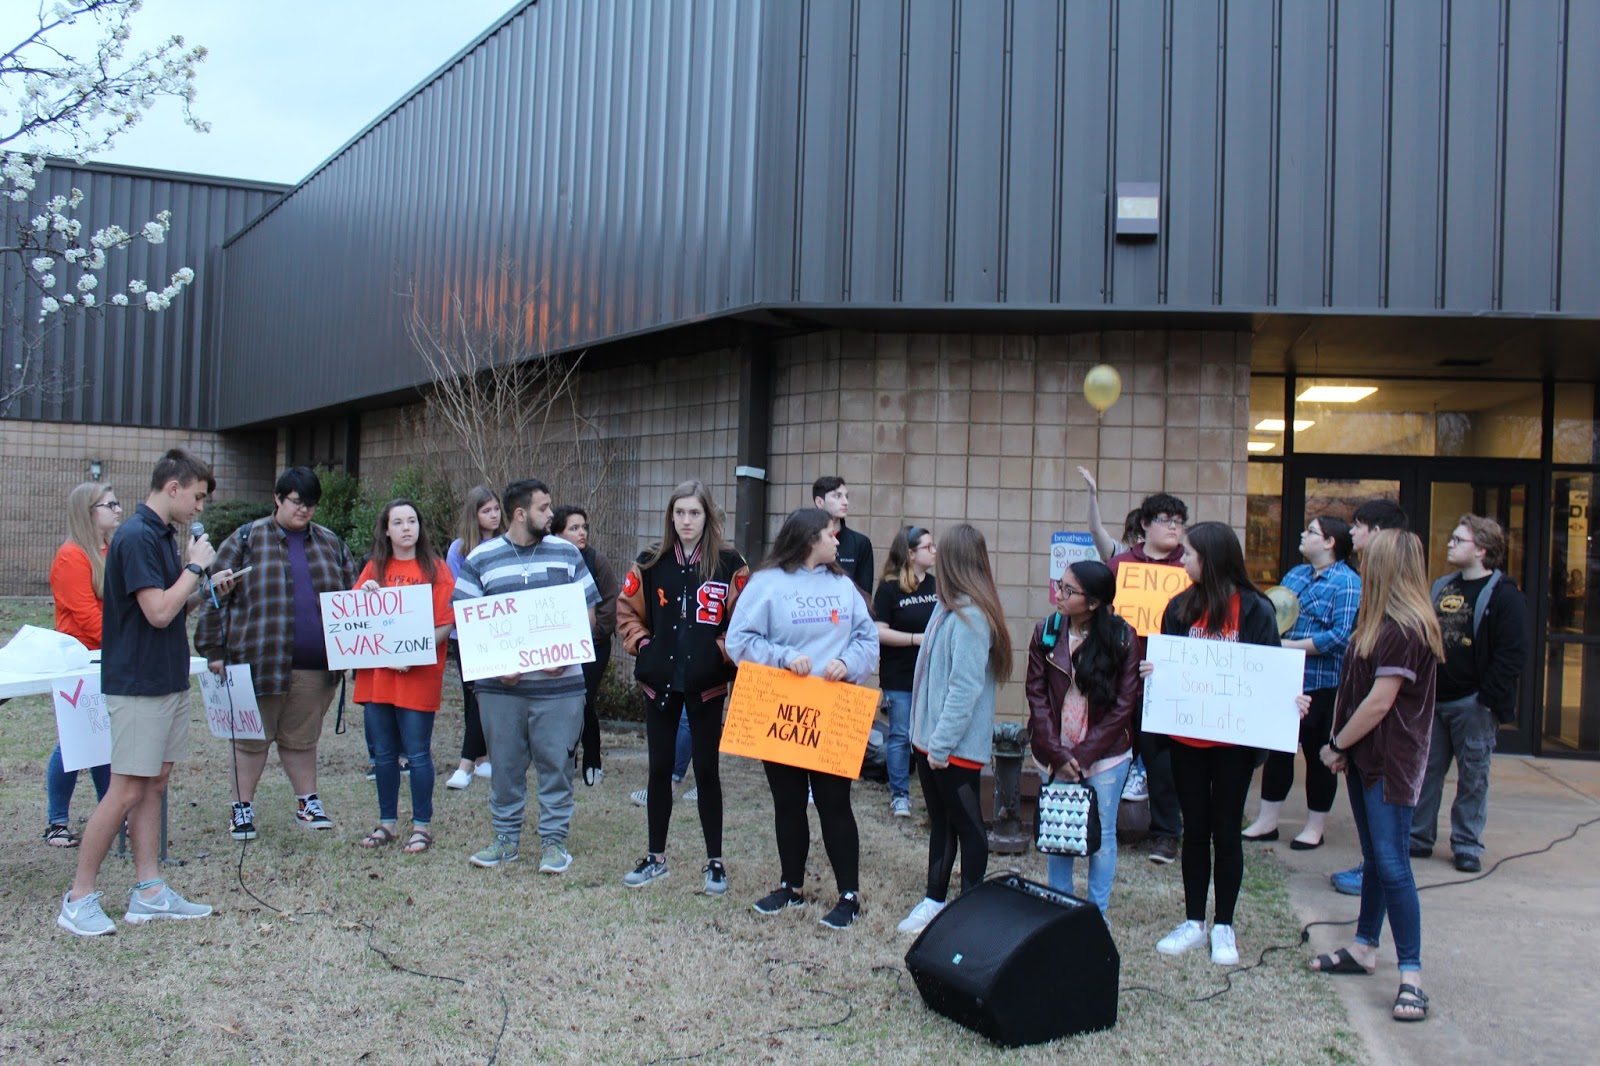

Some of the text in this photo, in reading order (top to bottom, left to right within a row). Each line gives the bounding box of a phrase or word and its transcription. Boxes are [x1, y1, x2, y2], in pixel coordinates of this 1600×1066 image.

[1069, 549, 1082, 557] no
[332, 590, 414, 620] SCHOOL
[463, 597, 555, 623] FEAR HAS
[696, 581, 729, 627] S
[791, 606, 848, 619] BODY SOP
[795, 595, 841, 609] SCOTT
[329, 618, 396, 634] ZONE OR
[489, 610, 570, 635] NO PLACE
[335, 633, 434, 656] WAR ZONE
[476, 636, 525, 654] IN OUR
[519, 639, 592, 668] SCHOOLS
[1160, 639, 1264, 673] It's Not Too
[777, 703, 821, 729] NEVER
[1165, 698, 1250, 733] Too Late
[767, 722, 821, 749] AGAIN
